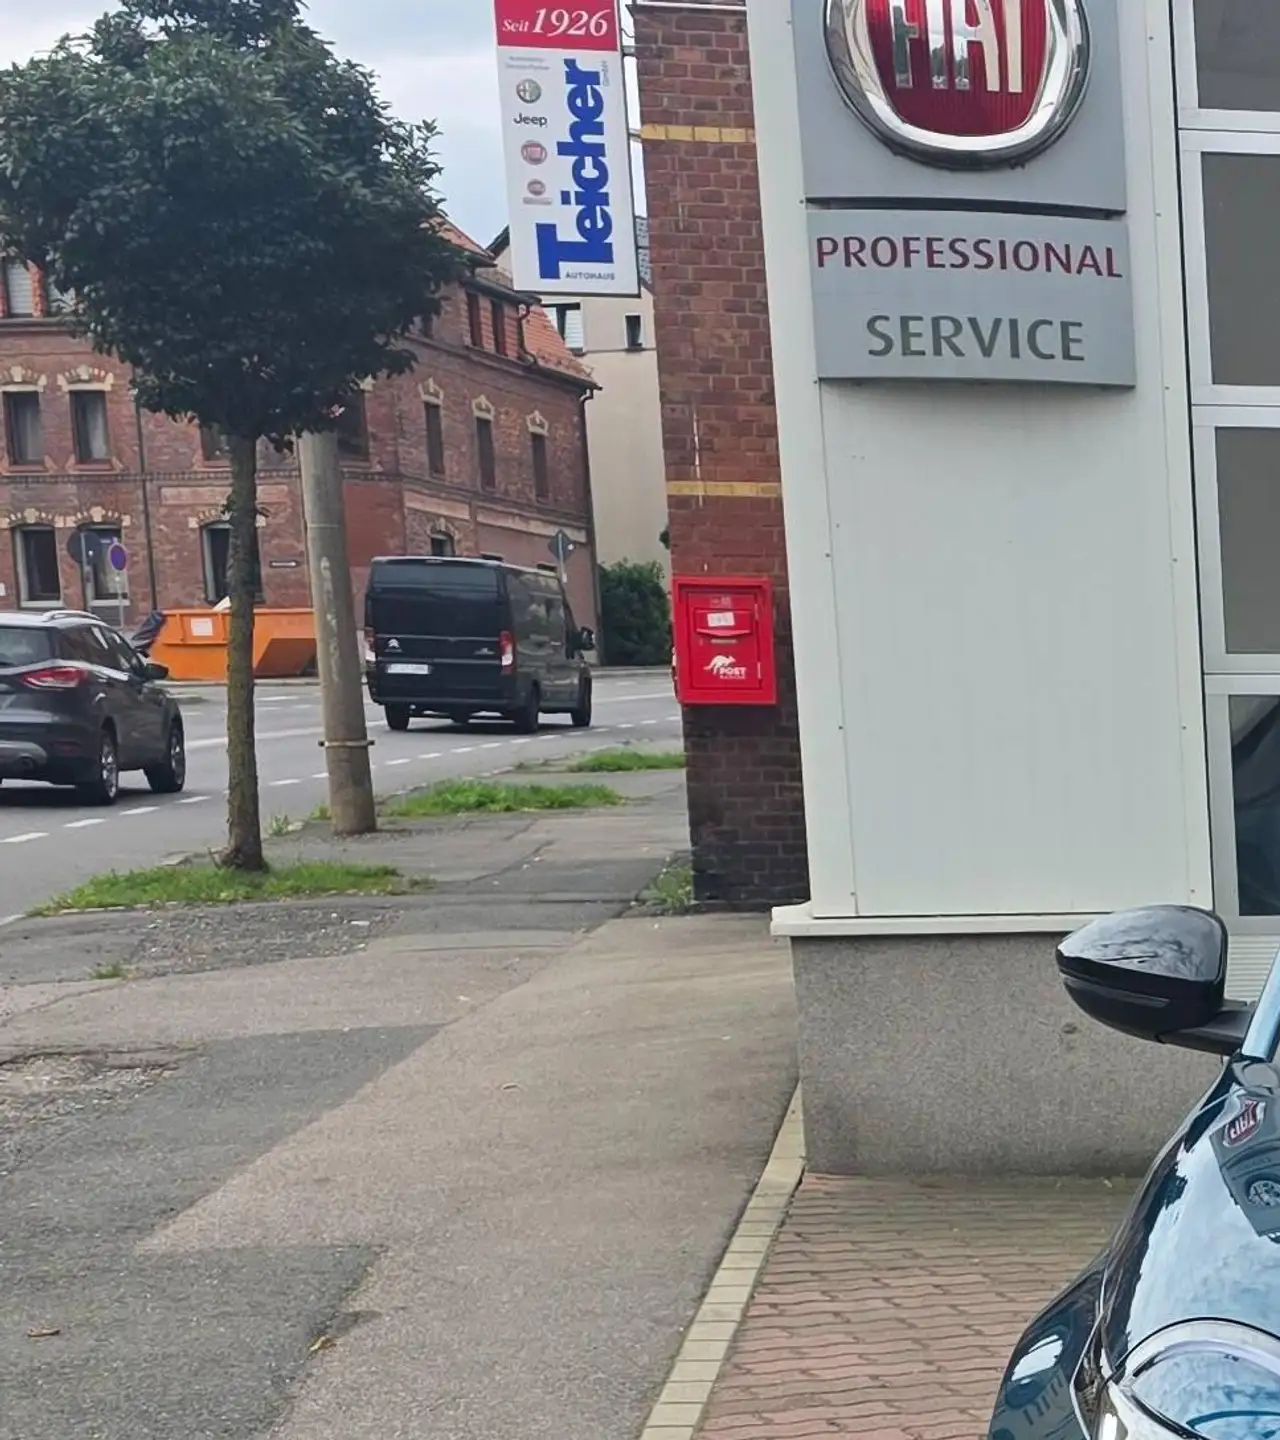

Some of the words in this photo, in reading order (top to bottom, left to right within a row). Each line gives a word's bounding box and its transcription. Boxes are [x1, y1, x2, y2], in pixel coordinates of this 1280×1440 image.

[502, 19, 530, 33] Seit
[532, 8, 611, 37] 1926
[890, 0, 1022, 93] FIAT
[513, 112, 548, 128] Jeep
[534, 58, 614, 280] Teicher
[816, 236, 1123, 278] PROFESSIONAL
[866, 314, 1085, 362] SERVICE
